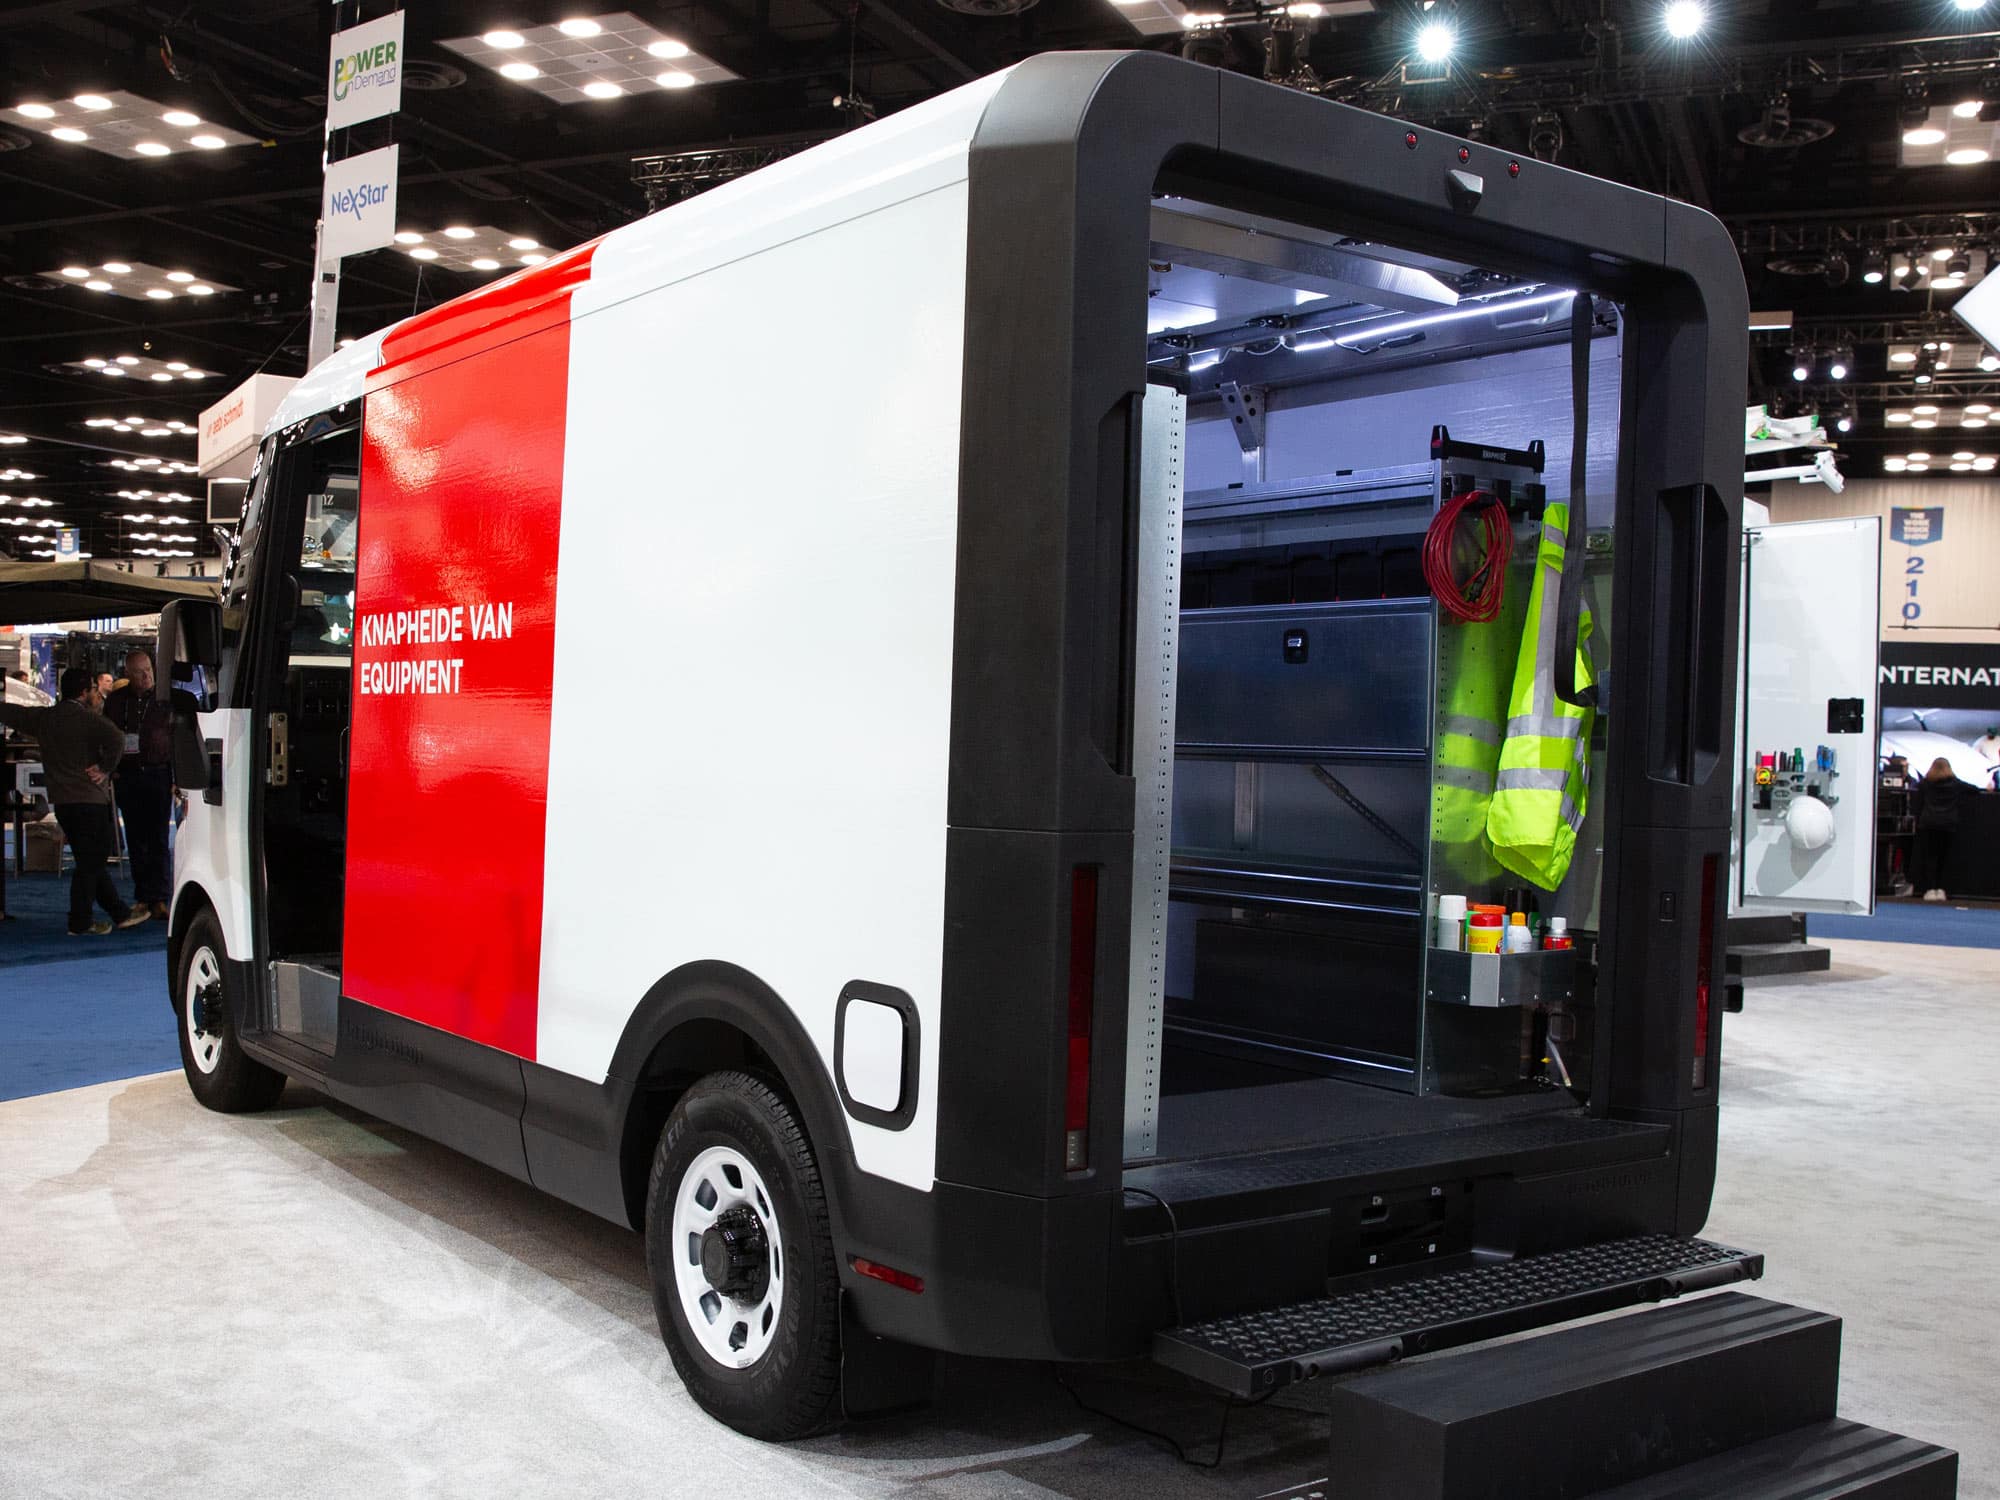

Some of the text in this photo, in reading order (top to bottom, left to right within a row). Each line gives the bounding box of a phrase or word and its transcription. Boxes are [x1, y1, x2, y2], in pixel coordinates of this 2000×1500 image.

[335, 40, 397, 81] POWER
[354, 63, 397, 90] Demand
[361, 602, 513, 647] KNAPHEIDE VAN
[360, 659, 464, 695] EQUIPMENT
